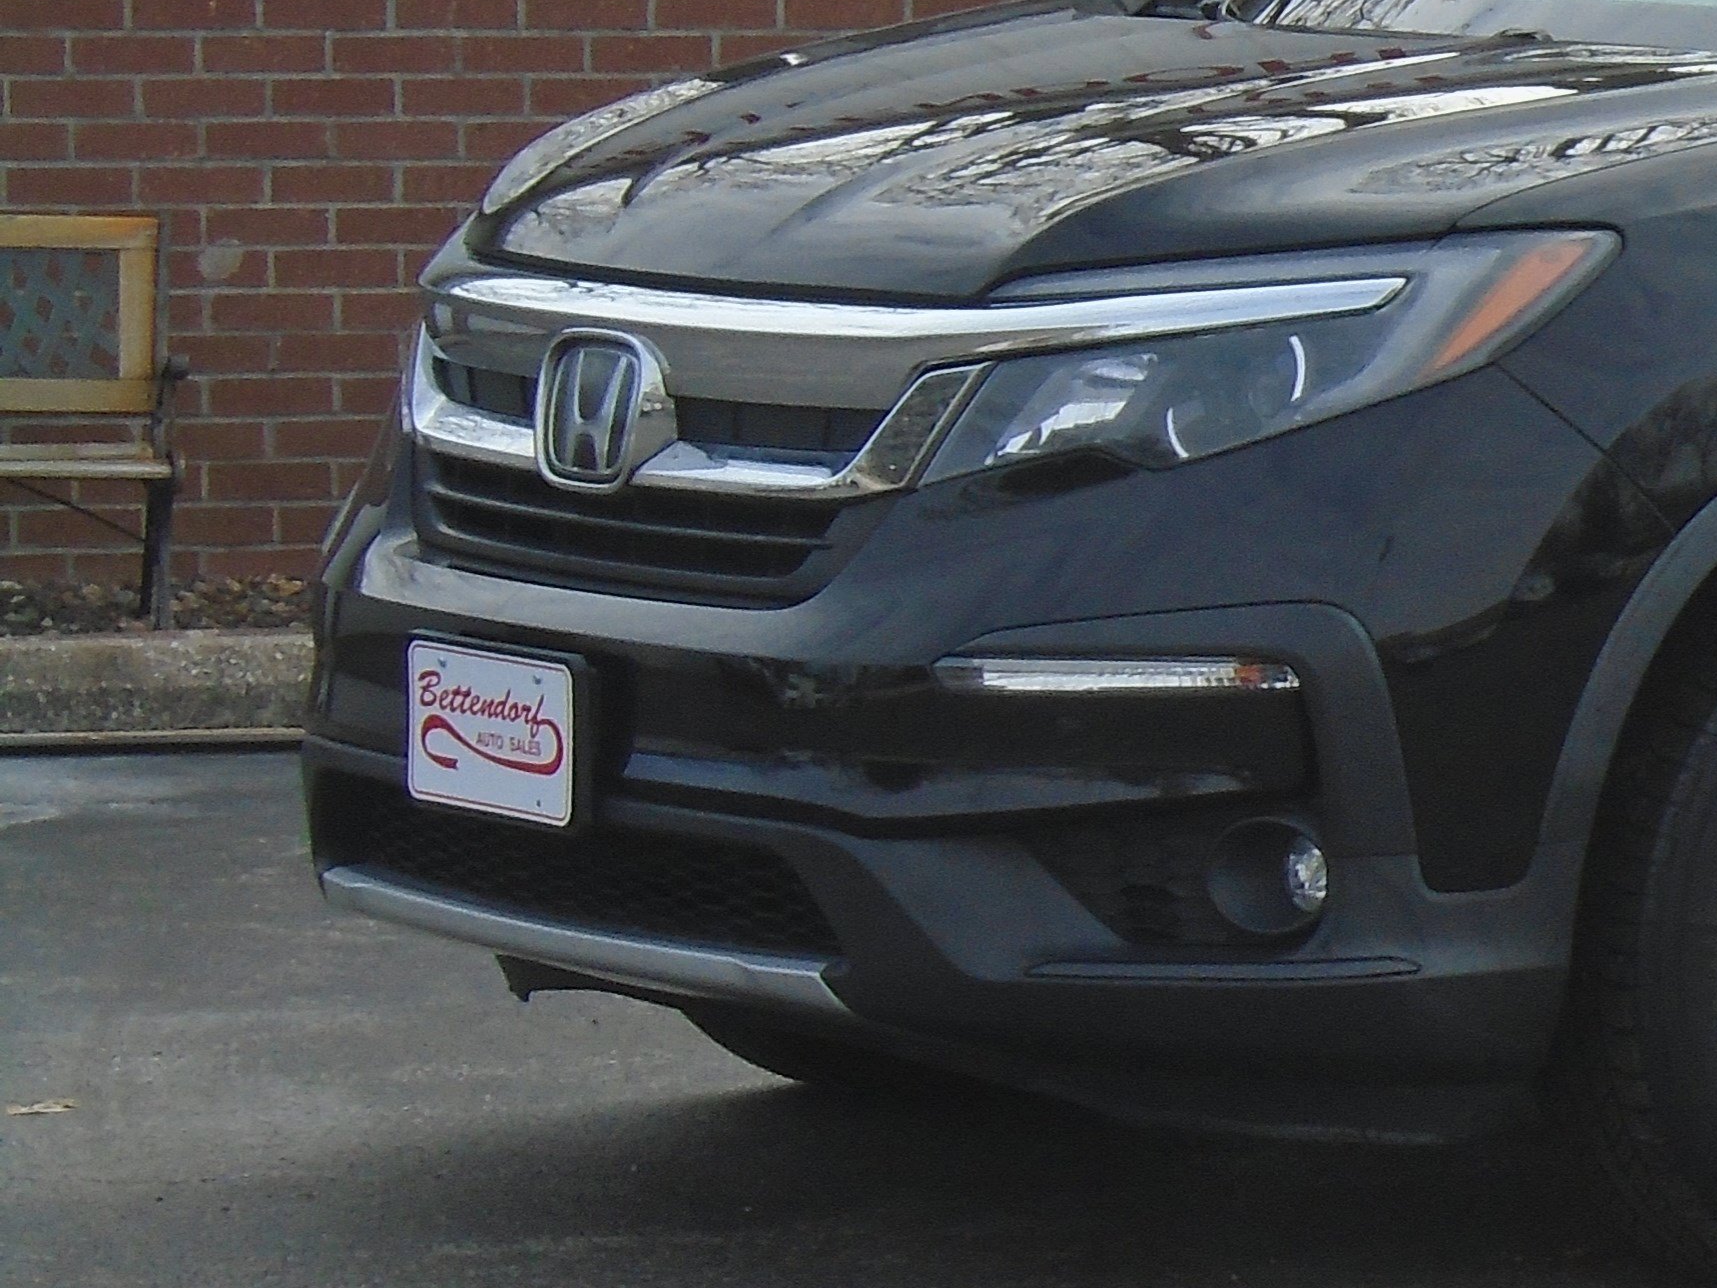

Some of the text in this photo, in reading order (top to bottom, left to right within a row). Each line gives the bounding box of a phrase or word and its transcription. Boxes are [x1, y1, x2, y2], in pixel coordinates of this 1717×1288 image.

[417, 669, 550, 738] Bettendorf
[476, 732, 542, 757] AUTO SALES
